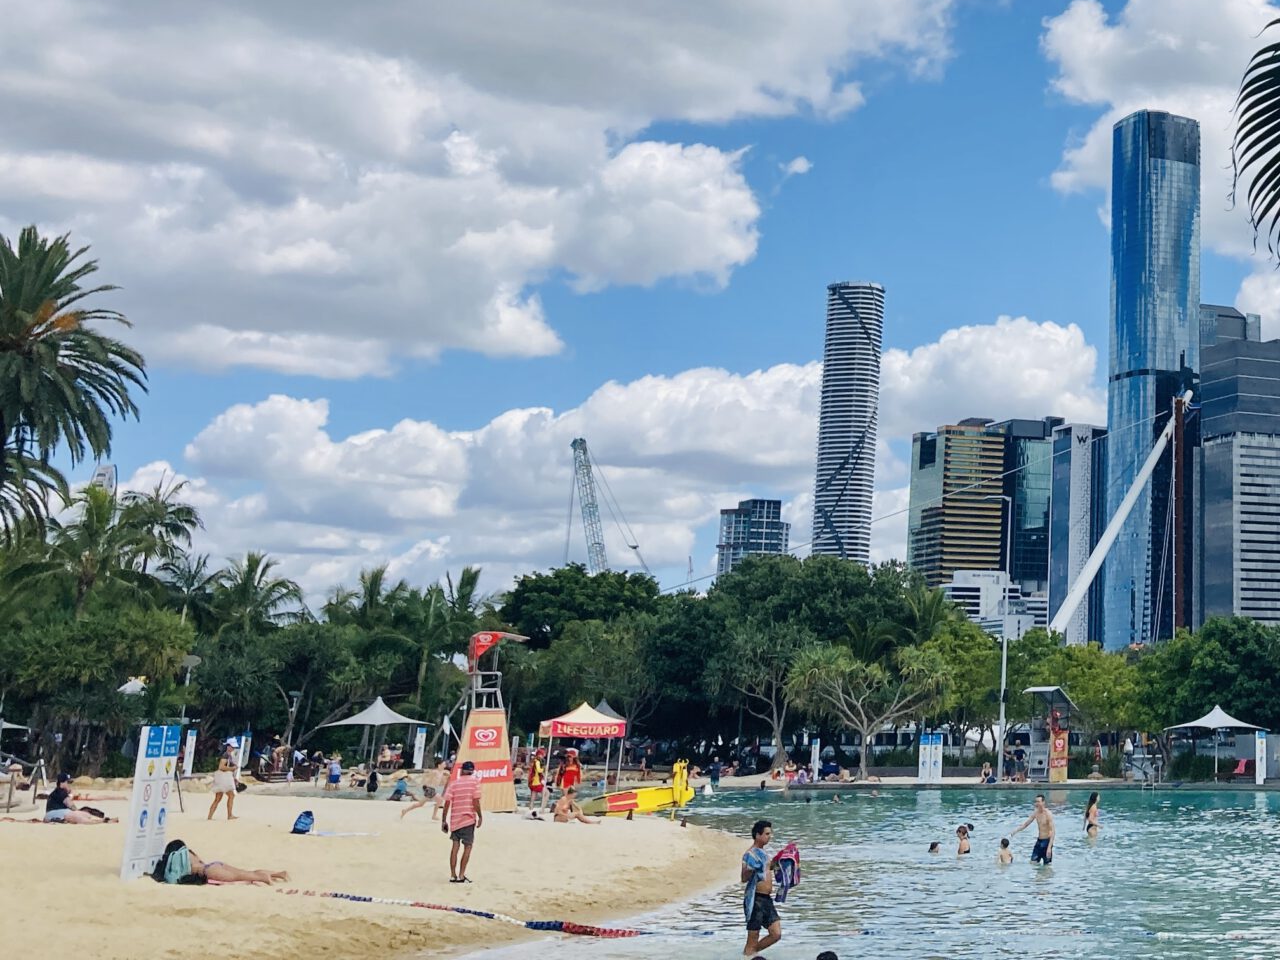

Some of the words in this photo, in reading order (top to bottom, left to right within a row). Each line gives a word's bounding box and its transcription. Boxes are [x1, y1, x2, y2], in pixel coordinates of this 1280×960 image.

[1077, 435, 1088, 445] W
[557, 723, 619, 735] LIFEGUARD
[456, 765, 508, 781] Leguard
